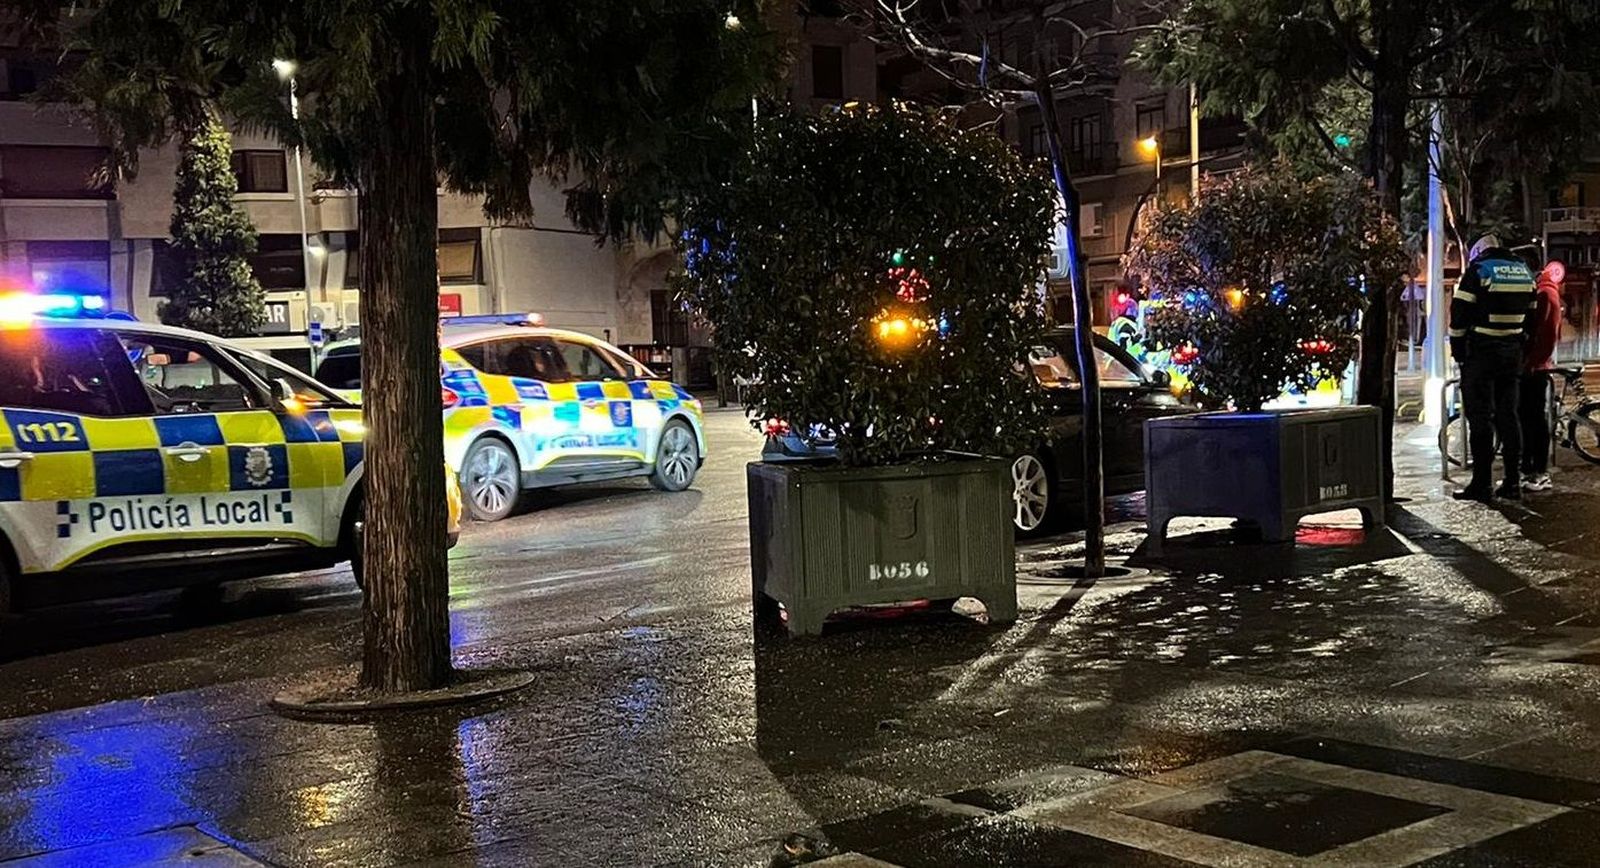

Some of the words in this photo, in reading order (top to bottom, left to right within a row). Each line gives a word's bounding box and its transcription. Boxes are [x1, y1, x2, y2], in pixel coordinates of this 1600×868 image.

[89, 497, 190, 533] Policía
[200, 494, 270, 526] Local
[869, 561, 929, 580] B056
